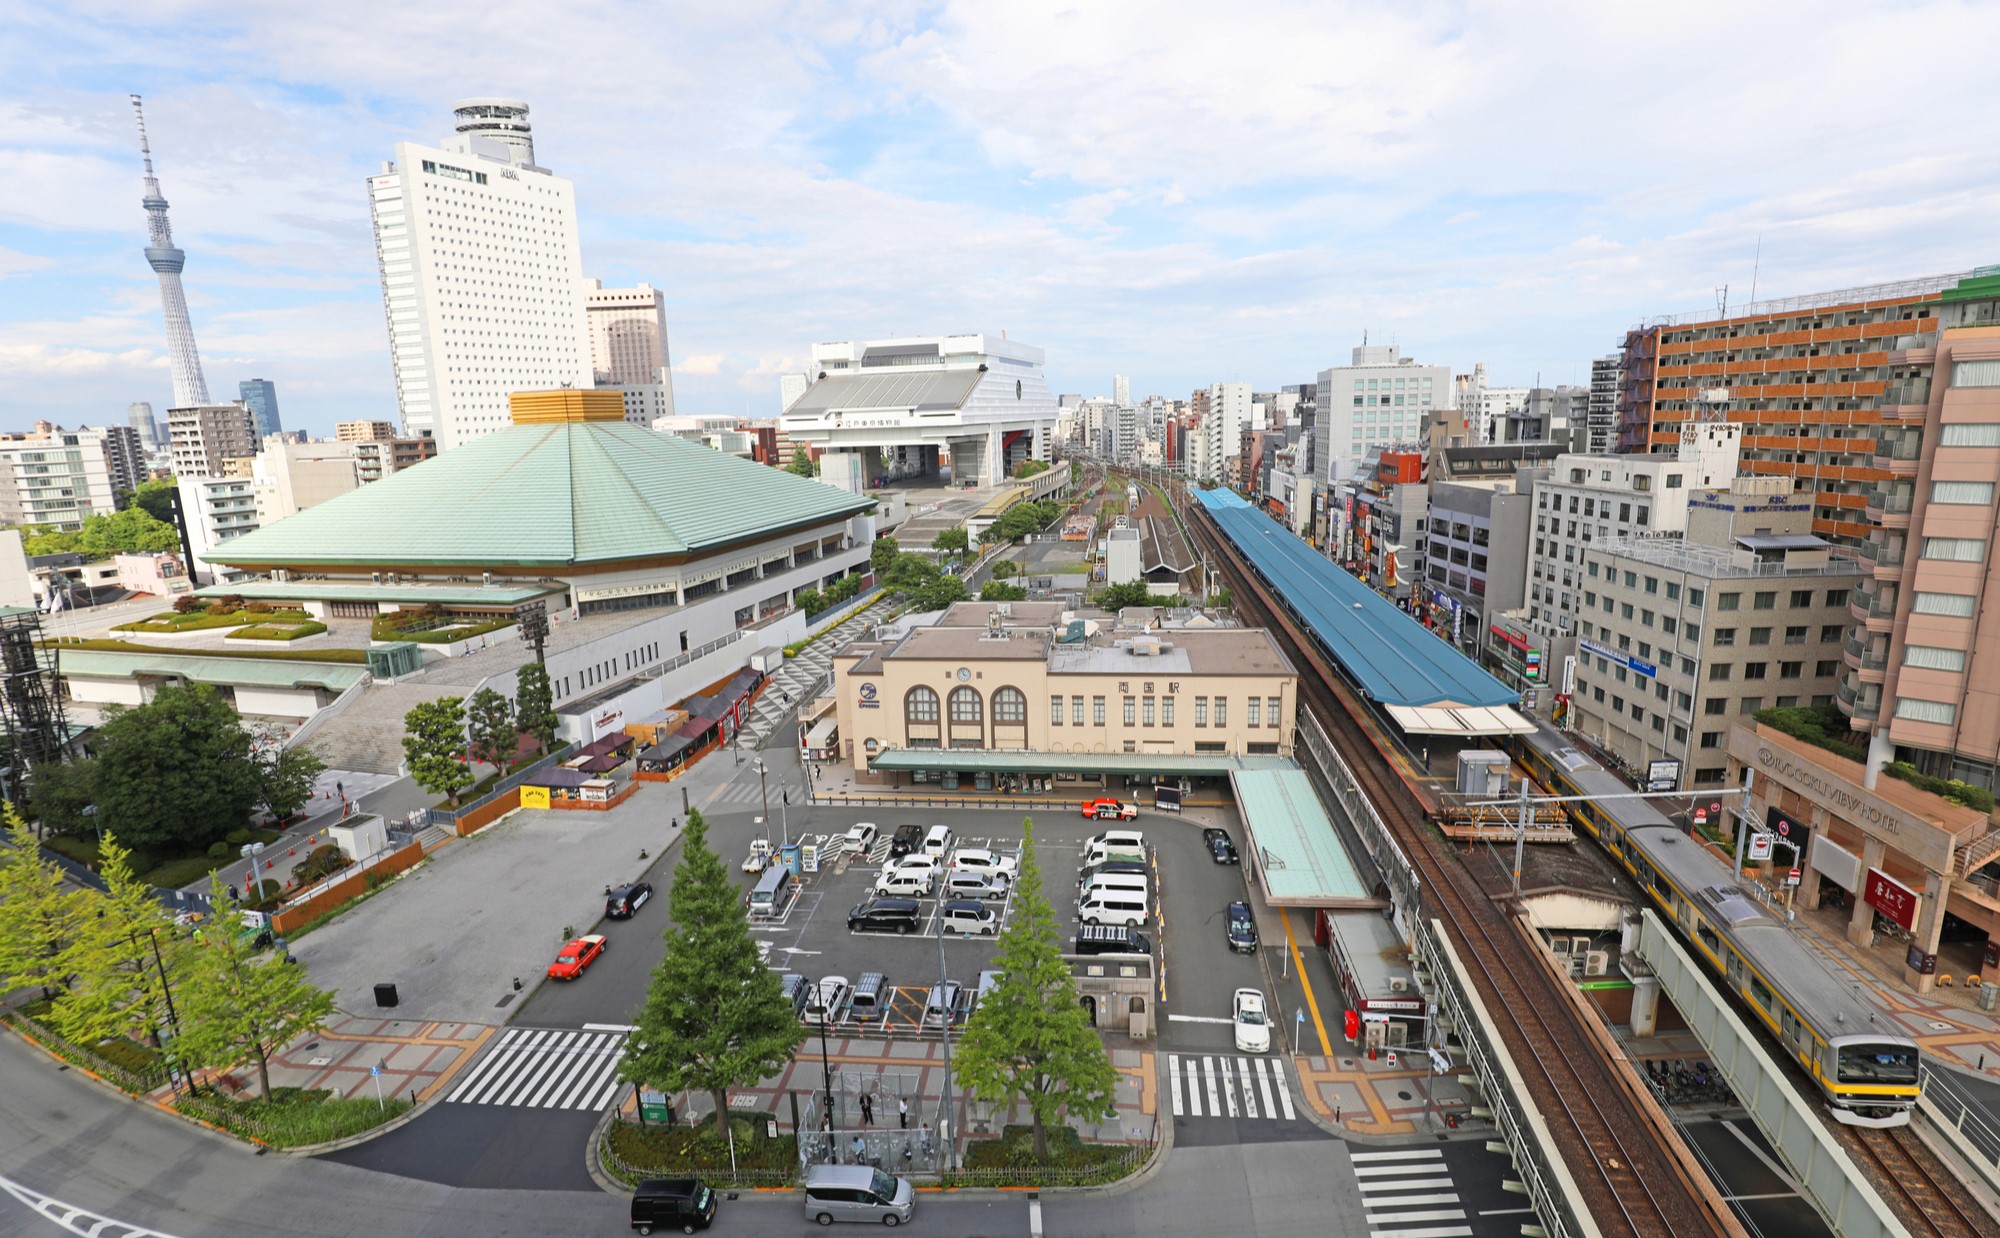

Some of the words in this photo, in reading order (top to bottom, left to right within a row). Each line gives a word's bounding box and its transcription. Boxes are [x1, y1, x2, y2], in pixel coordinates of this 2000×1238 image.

[1118, 682, 1180, 694] 両国駅
[1773, 757, 1827, 796] RYOGOKU
[1829, 788, 1861, 810] VIEW
[1861, 803, 1899, 835] HOTEL
